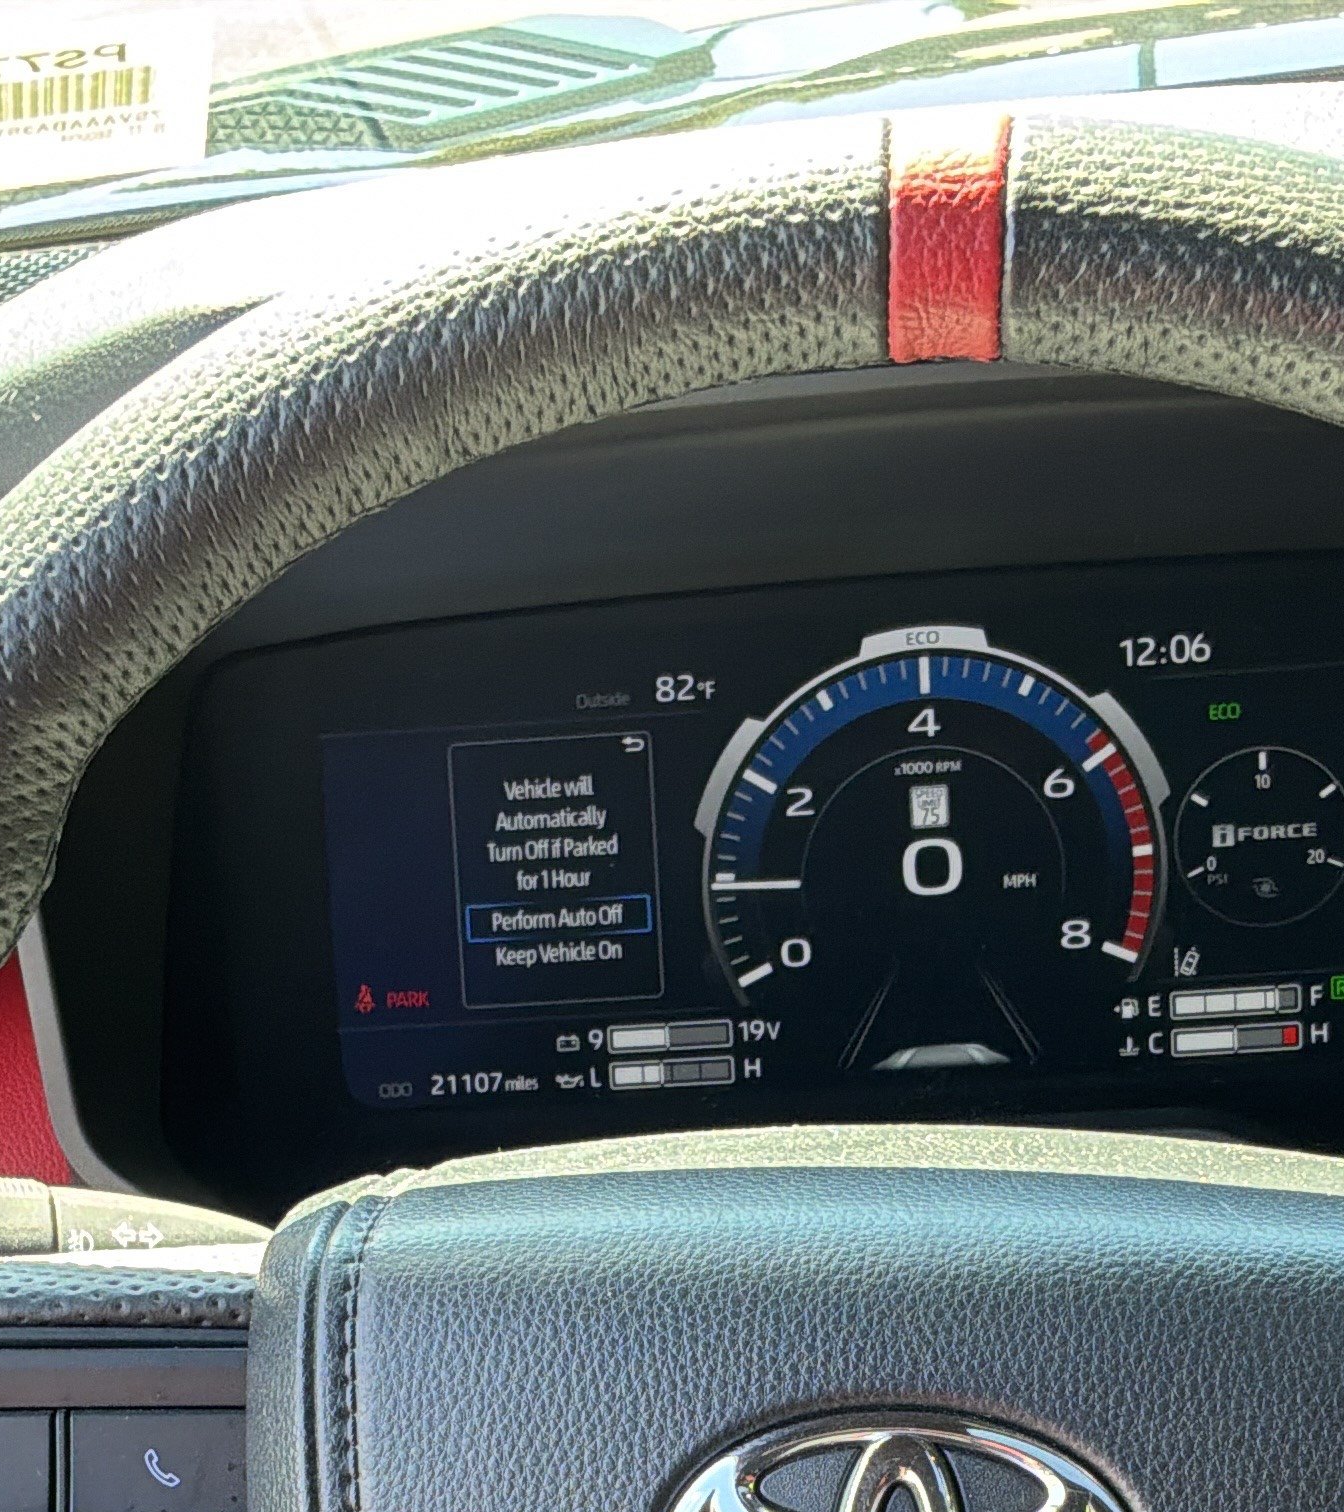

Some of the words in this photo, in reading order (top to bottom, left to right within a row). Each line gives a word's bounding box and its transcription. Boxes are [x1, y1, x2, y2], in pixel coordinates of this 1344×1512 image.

[905, 631, 940, 646] ECO
[1119, 632, 1212, 667] 12:06
[576, 692, 630, 709] Outside
[1208, 703, 1241, 721] ECO
[907, 708, 941, 737] 4
[935, 759, 962, 773] RPM
[503, 778, 561, 800] Vehicle
[563, 773, 594, 797] will
[1043, 769, 1075, 799] 6
[1254, 774, 1271, 789] 10
[785, 787, 816, 817] 2
[495, 804, 607, 831] Automatically
[921, 808, 941, 826] 75
[487, 841, 523, 863] Turn
[524, 838, 549, 860] Off
[551, 837, 562, 859] if
[563, 832, 618, 858] Parked
[1306, 848, 1325, 865] 20
[902, 838, 963, 896] 0
[1206, 855, 1217, 872] 0
[517, 869, 538, 891] for
[540, 869, 549, 889] 1
[551, 869, 591, 889] Hour
[1003, 873, 1037, 889] MPH
[1207, 871, 1229, 885] PSI
[492, 909, 555, 931] Perform
[557, 907, 596, 928] Auto
[598, 903, 623, 925] Off
[1061, 919, 1091, 949] 8
[496, 946, 537, 968] Keep
[538, 941, 596, 964] Vehicle
[598, 940, 623, 960] On
[780, 938, 812, 968] 0
[386, 989, 430, 1008] PARK
[1147, 996, 1162, 1017] E
[1310, 984, 1325, 1007] F
[588, 1030, 604, 1050] 9
[738, 1021, 781, 1042] 19V
[1148, 1032, 1163, 1054] C
[1311, 1022, 1330, 1044] H
[379, 1081, 413, 1098] ODO
[430, 1072, 503, 1096] 21107
[504, 1073, 539, 1092] miles
[589, 1067, 602, 1088] L
[744, 1058, 762, 1079] H
